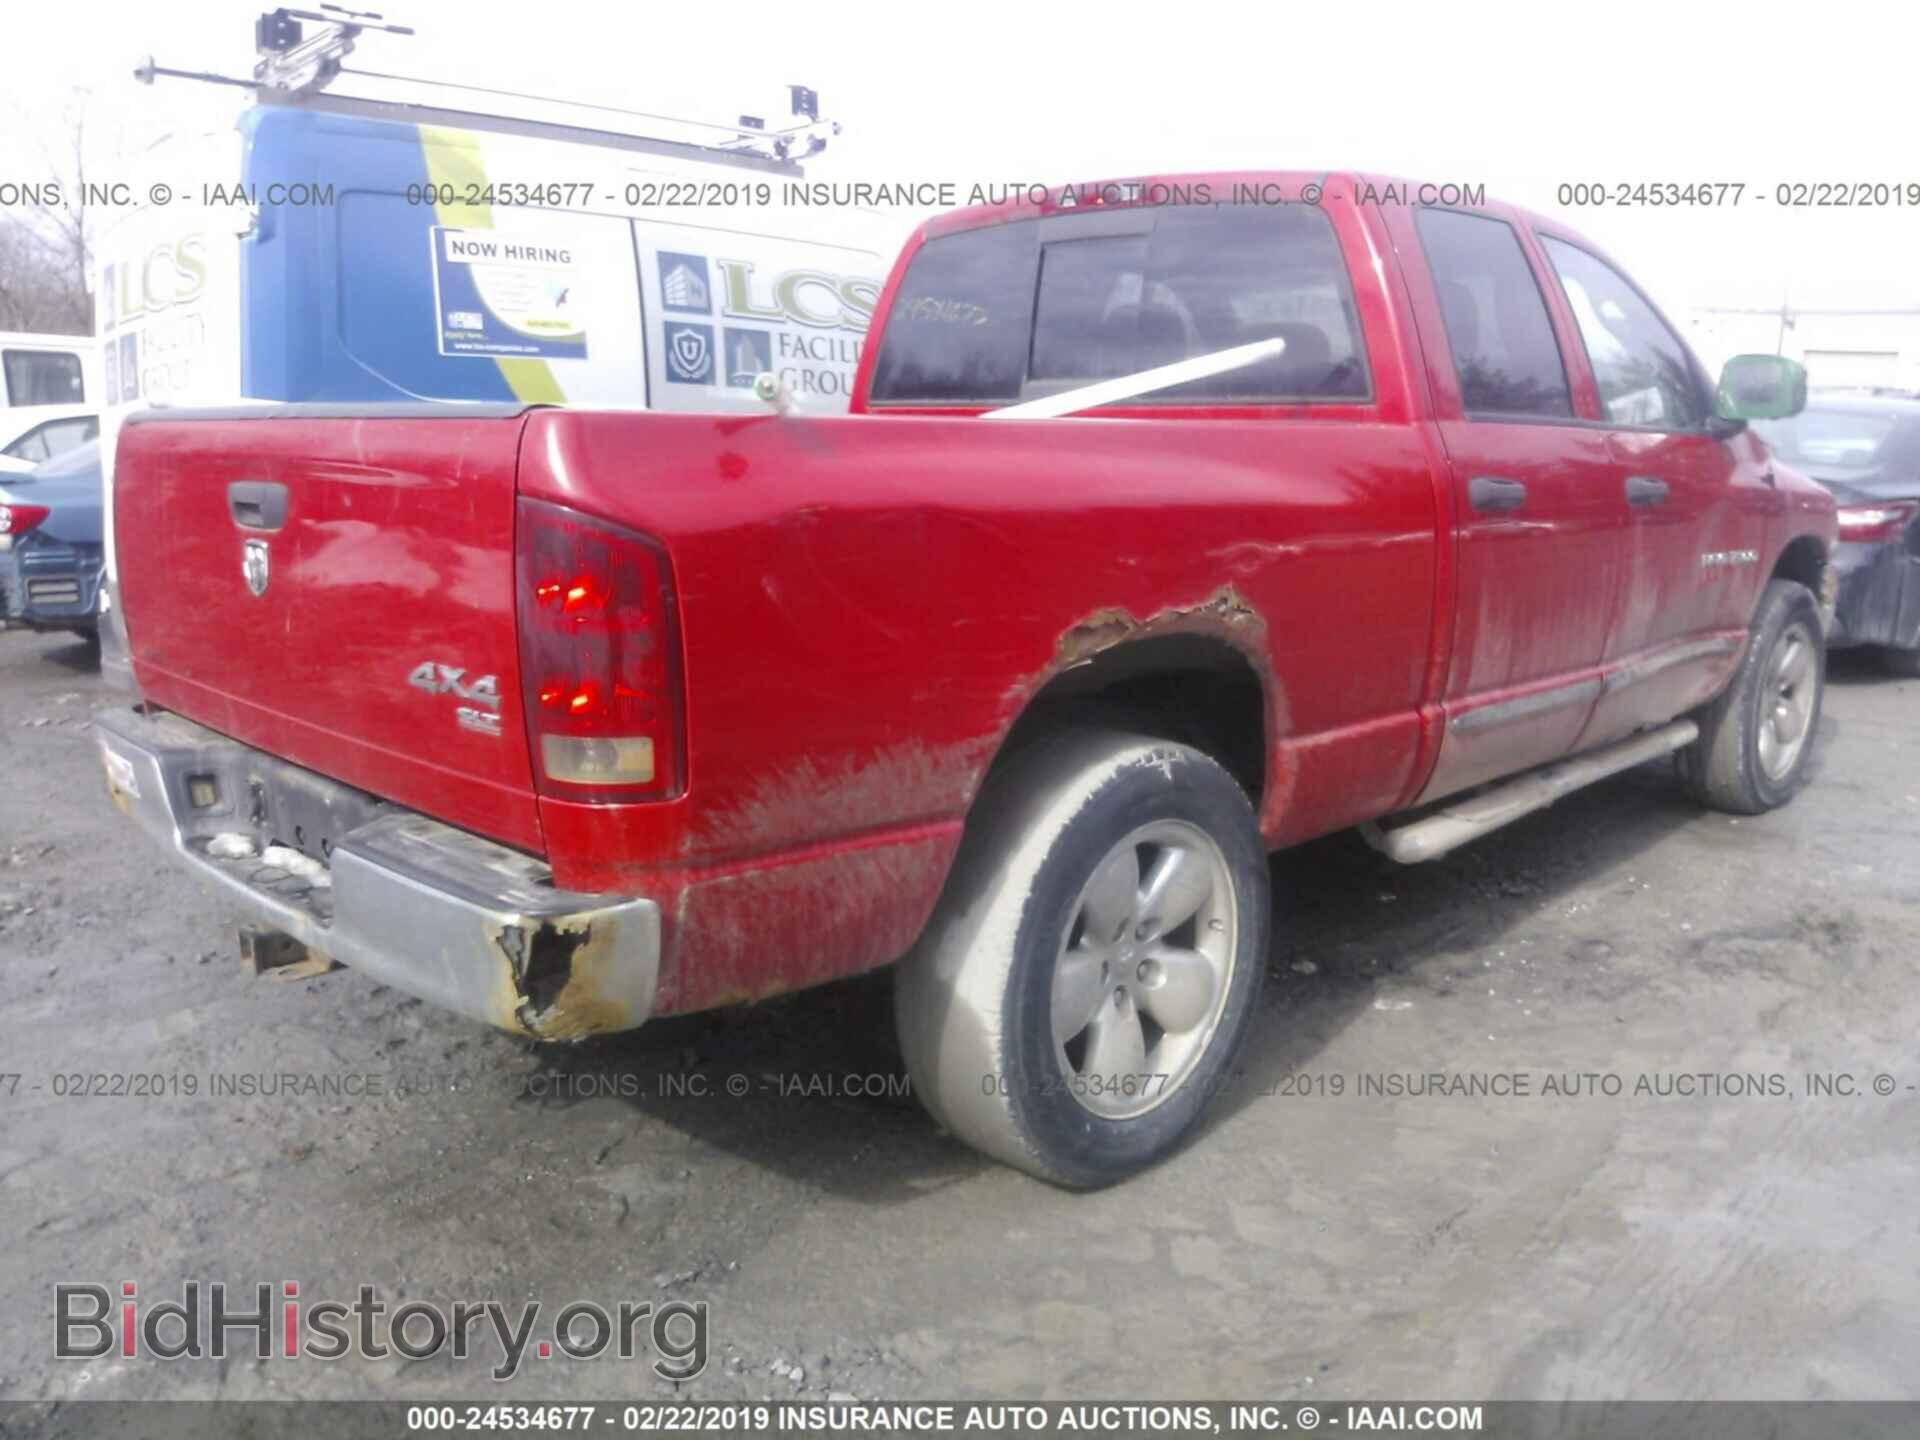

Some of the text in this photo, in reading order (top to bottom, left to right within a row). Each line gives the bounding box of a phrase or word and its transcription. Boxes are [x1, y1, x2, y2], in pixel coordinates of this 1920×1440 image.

[452, 239, 572, 264] NOW HIRING
[716, 259, 882, 334] LCS
